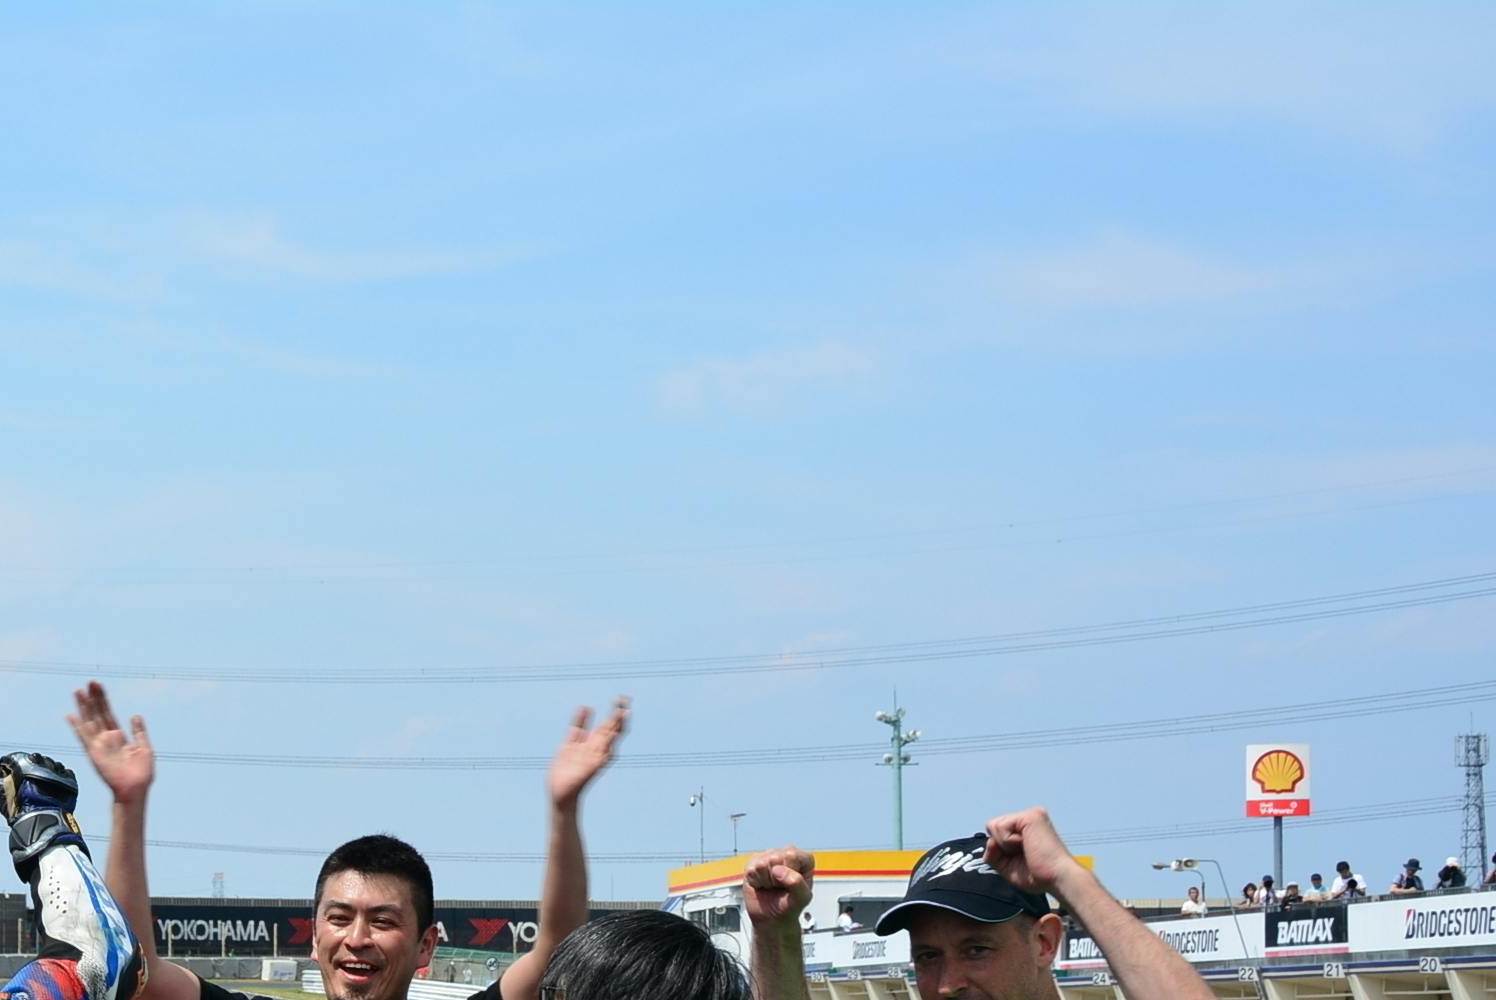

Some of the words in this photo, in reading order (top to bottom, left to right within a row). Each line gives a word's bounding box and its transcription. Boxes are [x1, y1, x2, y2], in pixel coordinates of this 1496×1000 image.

[157, 918, 270, 941] YOKOHAMA
[1326, 962, 1341, 978] 21
[1421, 956, 1438, 974] 20
[1093, 972, 1106, 985] 24
[1239, 966, 1255, 981] 22
